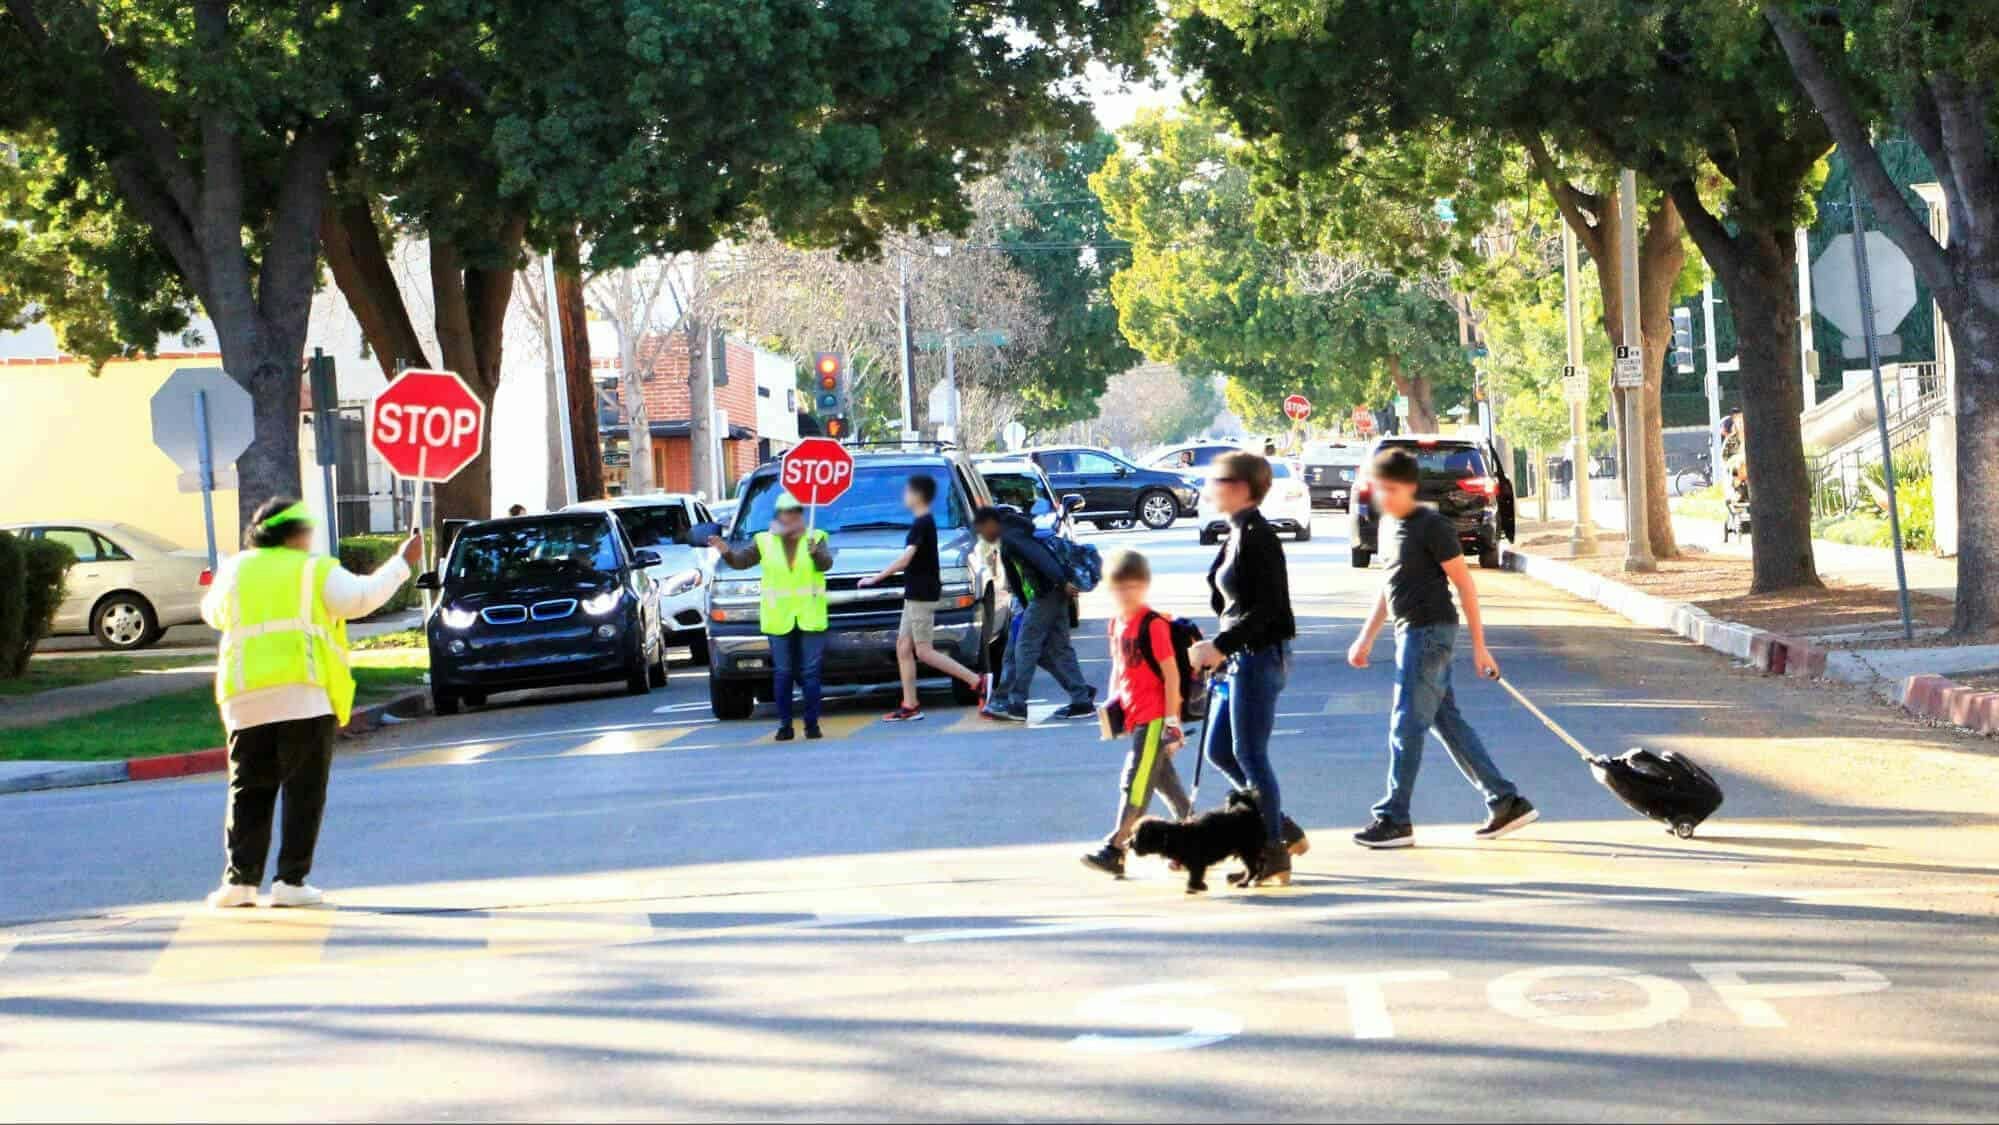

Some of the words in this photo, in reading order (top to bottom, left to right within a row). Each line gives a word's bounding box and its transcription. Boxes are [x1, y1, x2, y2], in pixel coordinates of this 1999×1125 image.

[376, 402, 477, 448] STOP
[1286, 401, 1308, 413] STOP
[785, 458, 850, 485] STOP
[1065, 961, 1892, 1054] STOP
